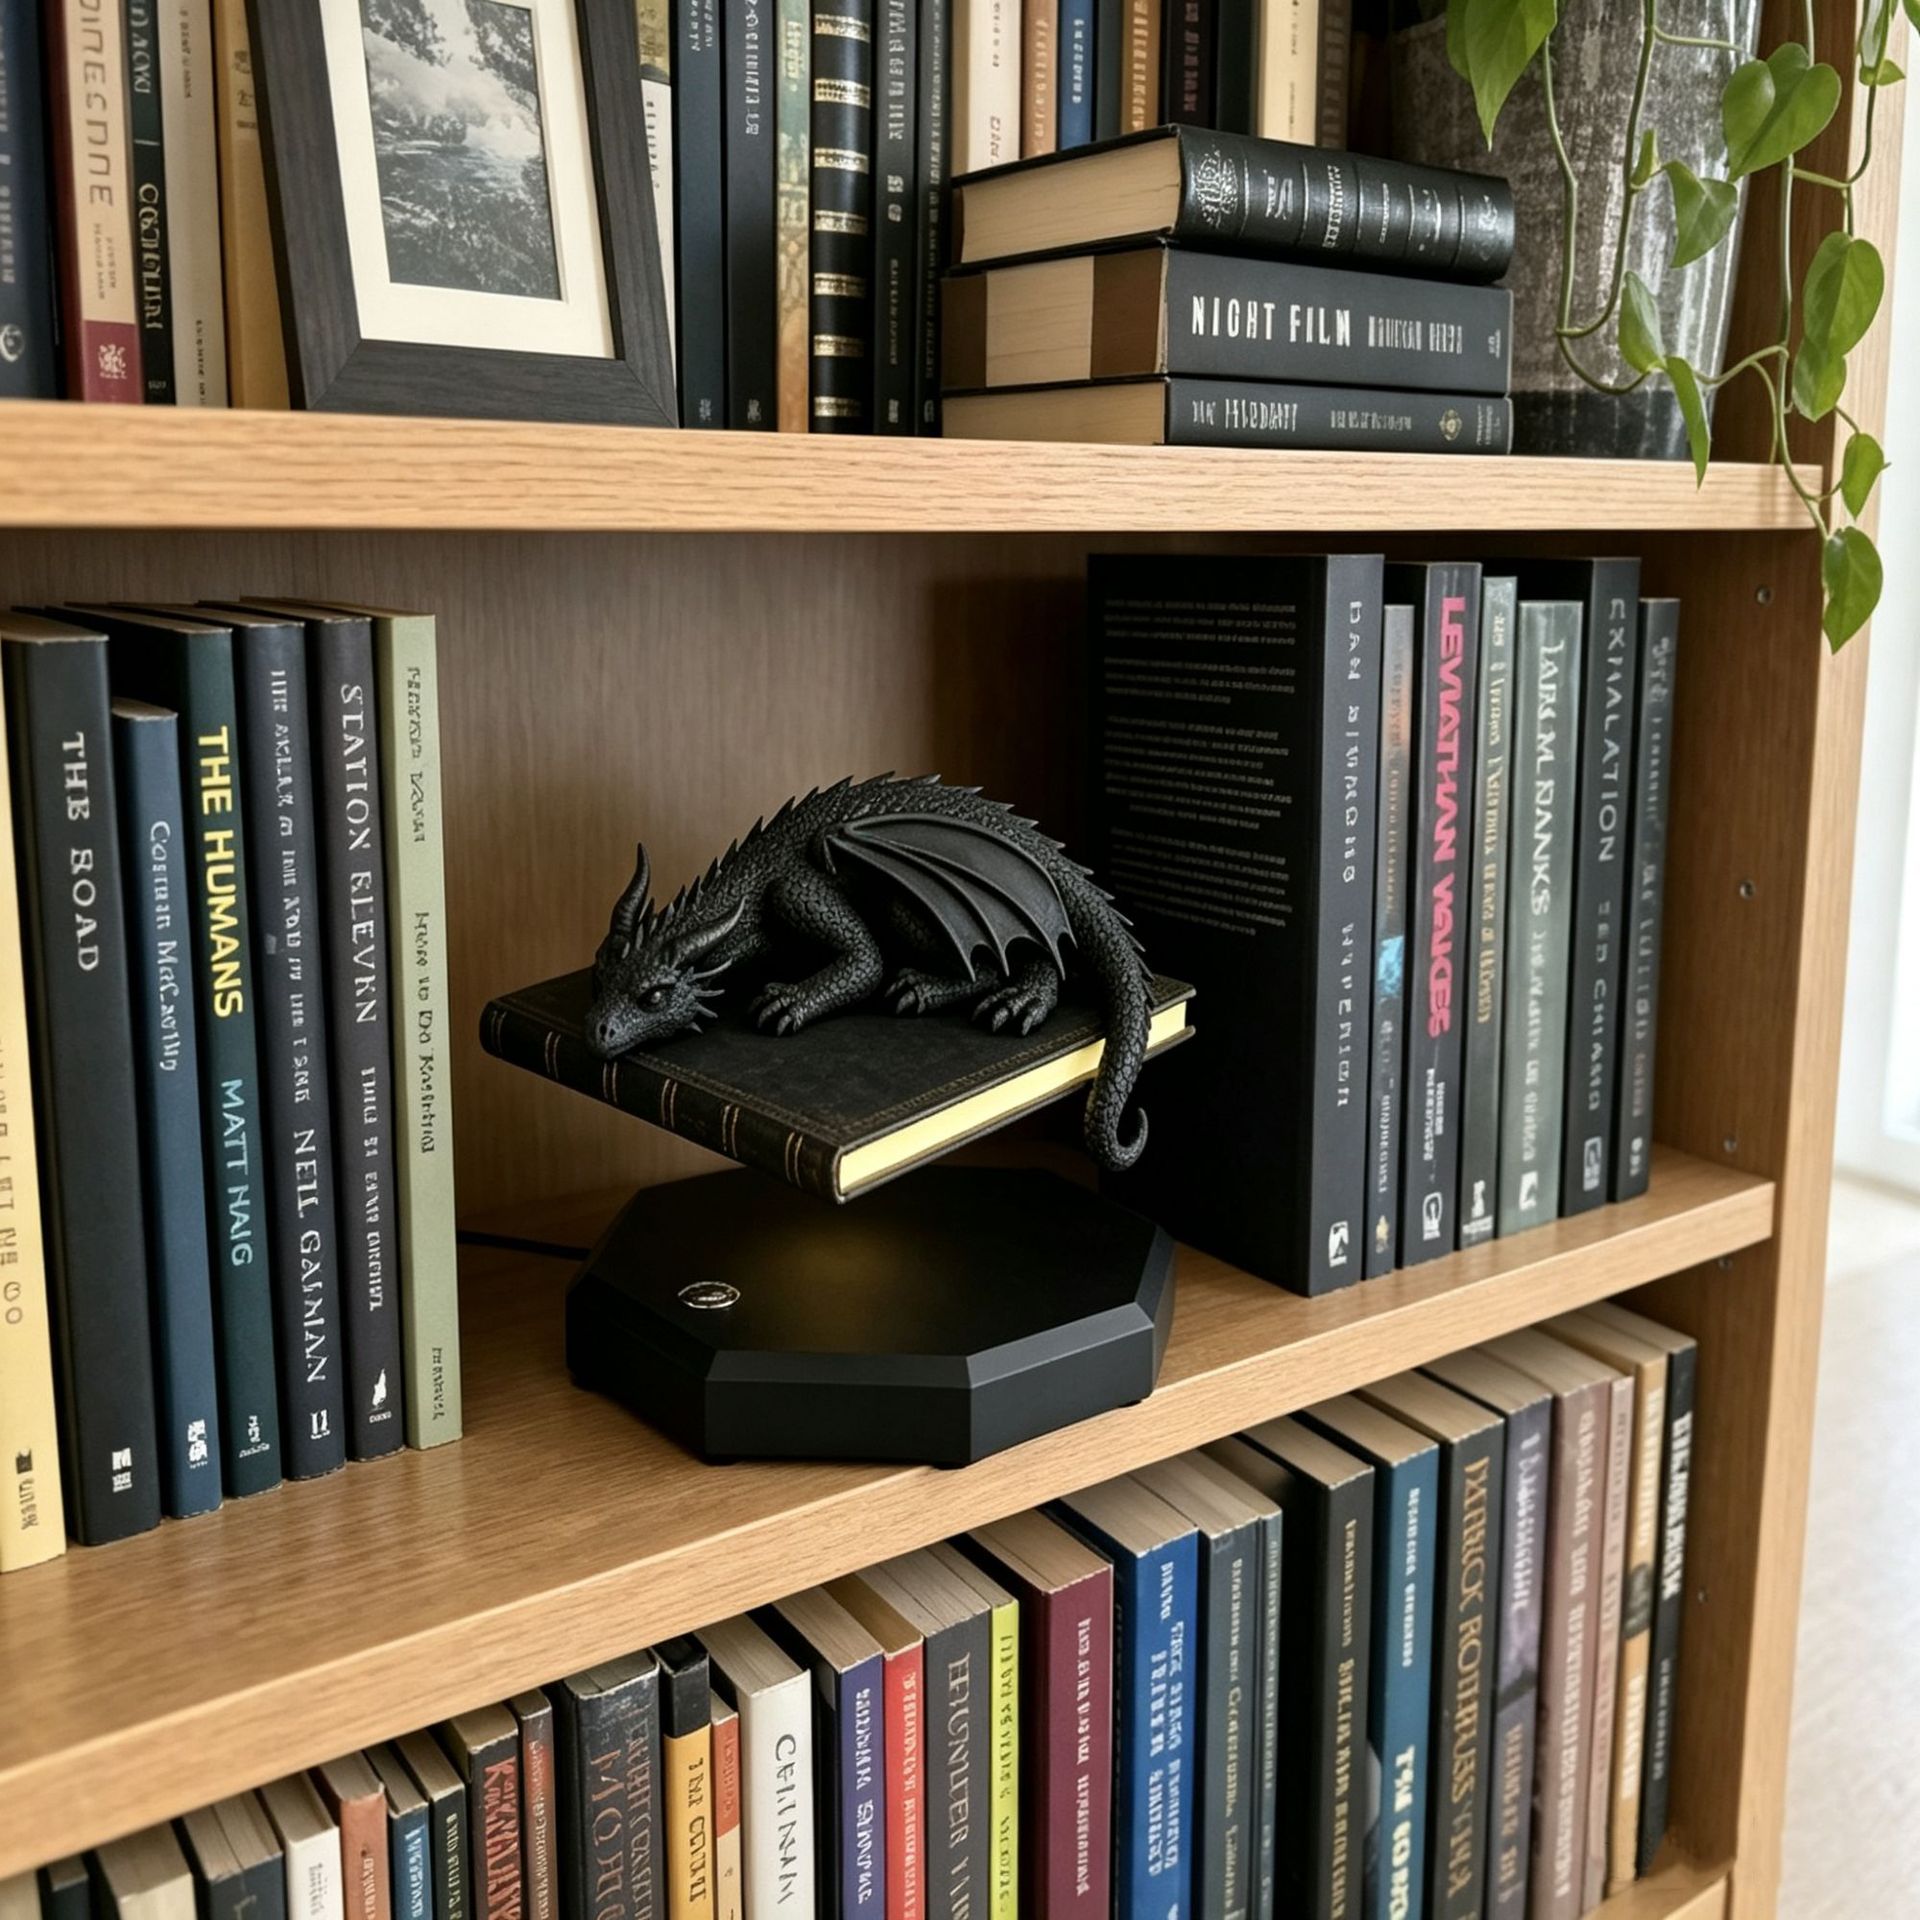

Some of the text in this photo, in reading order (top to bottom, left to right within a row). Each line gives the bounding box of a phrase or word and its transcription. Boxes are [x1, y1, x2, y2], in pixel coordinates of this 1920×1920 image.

[1192, 295, 1275, 341] NIGHT
[198, 726, 233, 815] THE
[1432, 597, 1466, 862] LEVIATHAN
[204, 830, 243, 1018] HUMANS
[221, 1078, 249, 1176] MATT
